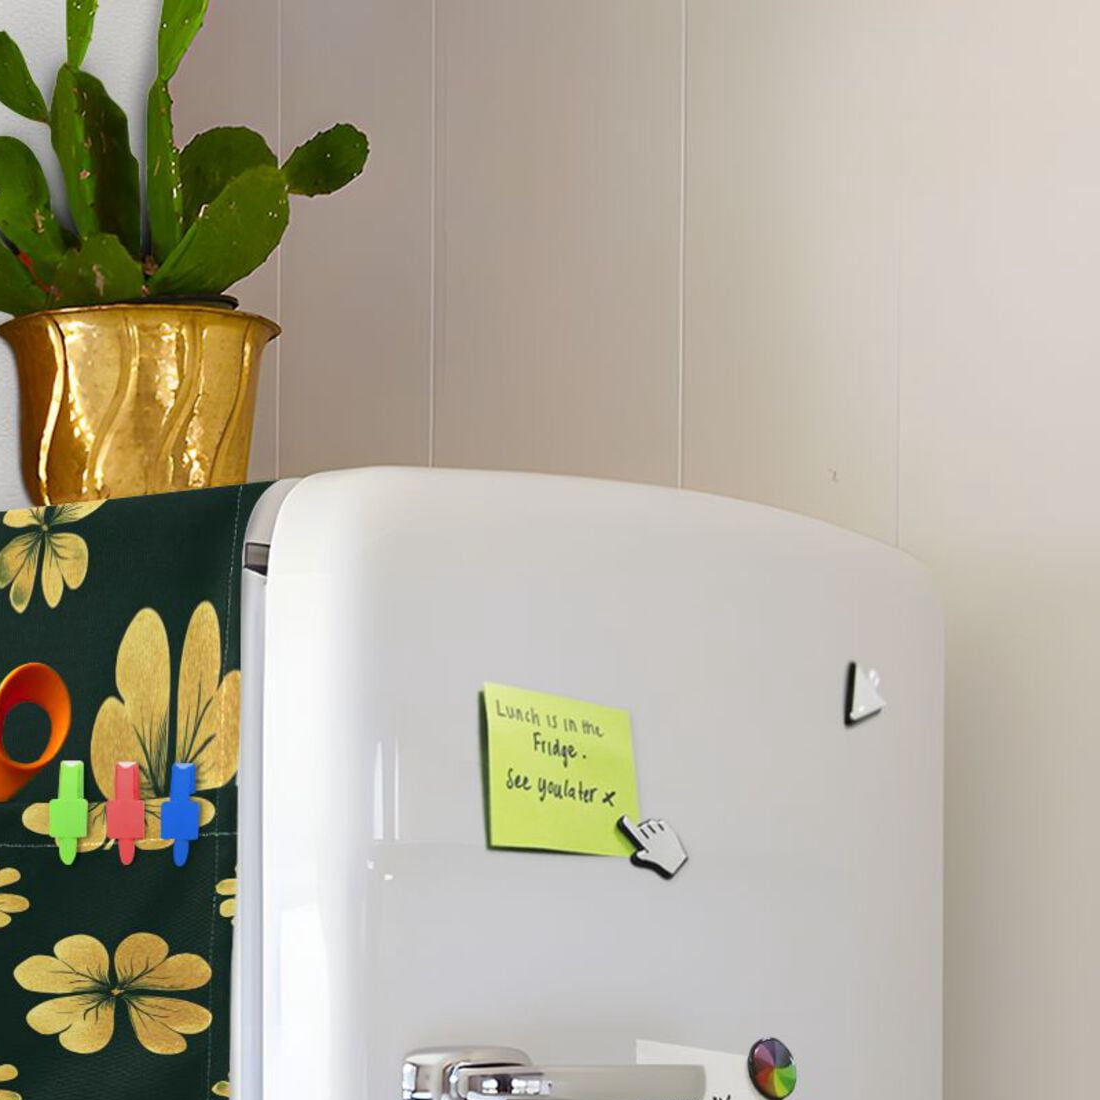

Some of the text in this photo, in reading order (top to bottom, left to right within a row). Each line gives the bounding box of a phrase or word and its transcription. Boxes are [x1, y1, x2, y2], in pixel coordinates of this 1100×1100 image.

[496, 699, 605, 738] Lunch is in the
[506, 768, 532, 791] See
